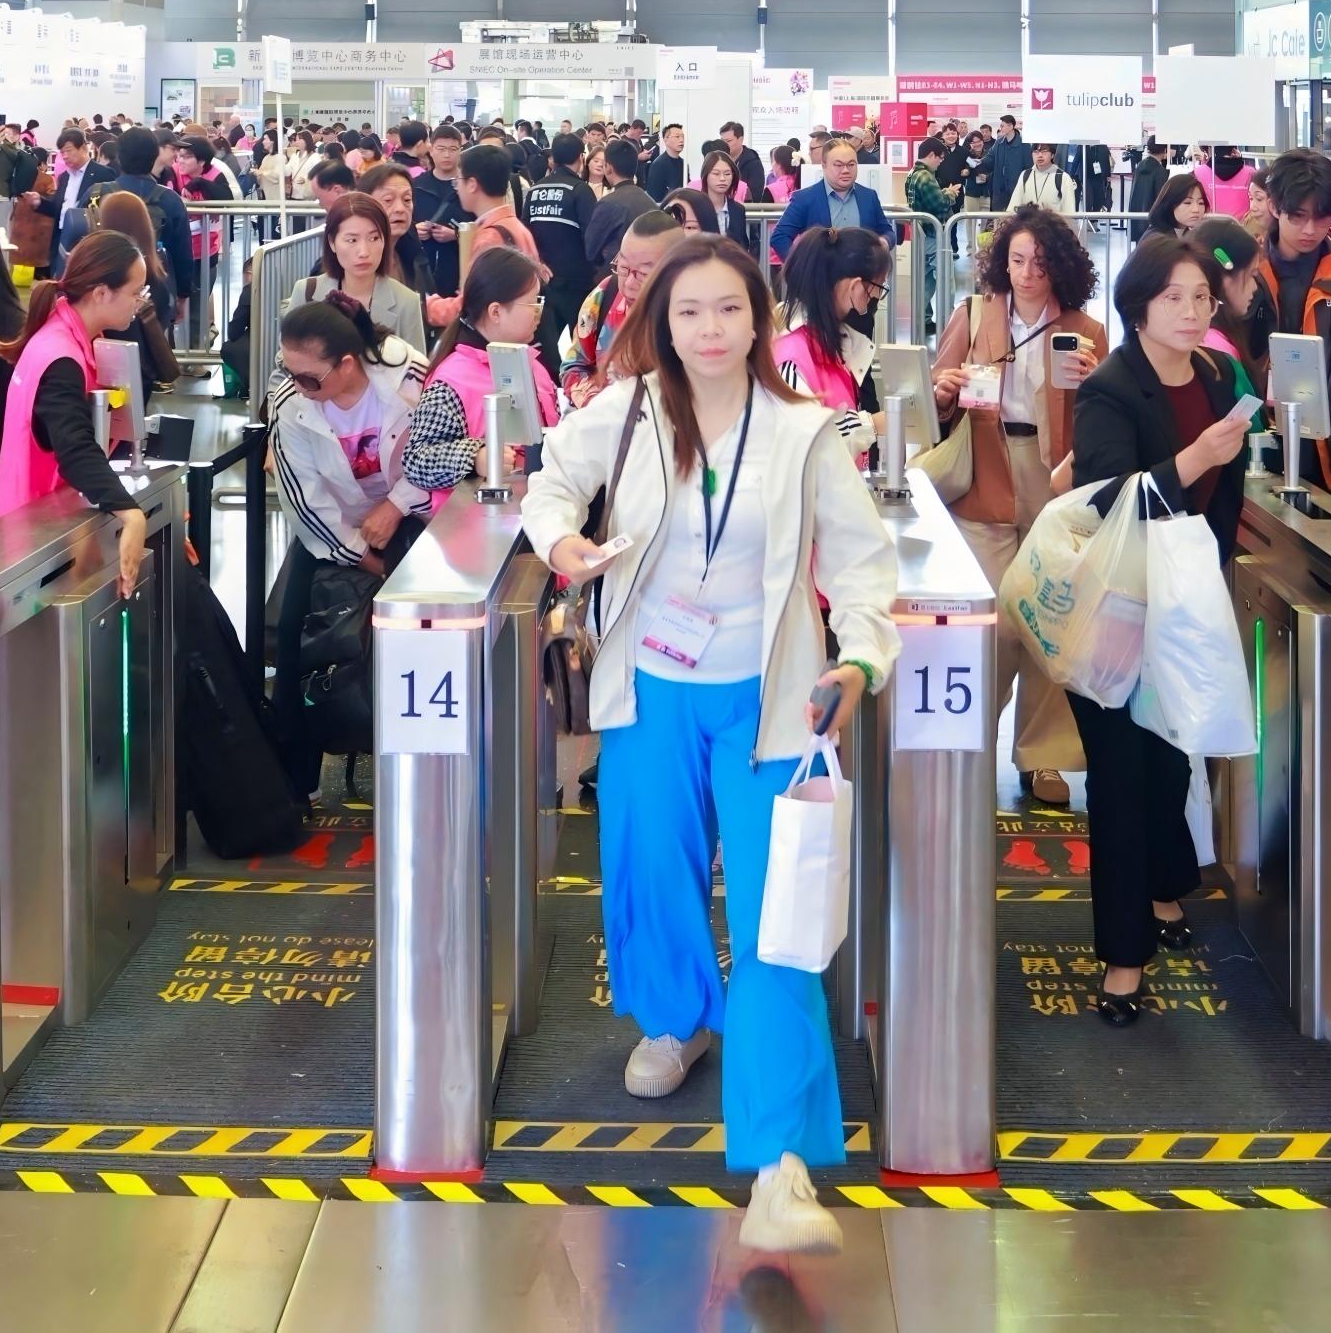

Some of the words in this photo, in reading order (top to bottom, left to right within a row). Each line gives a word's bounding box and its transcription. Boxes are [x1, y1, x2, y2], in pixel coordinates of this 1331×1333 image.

[248, 49, 406, 63] 新博览中心商务中心
[479, 48, 584, 61] 展馆现场运营中心
[675, 62, 698, 72] 入口
[1066, 92, 1134, 109] tulipclub
[400, 670, 459, 719] 14
[913, 667, 972, 715] 15
[284, 934, 312, 945] do
[319, 937, 374, 948] lease
[1003, 942, 1047, 955] stay
[184, 945, 373, 969] 请勿停留
[174, 967, 234, 980] step
[242, 972, 284, 982] the
[292, 973, 361, 984] mind
[1026, 980, 1088, 993] step
[157, 981, 356, 1007] 小心台阶
[1030, 994, 1228, 1017] 小心阶
